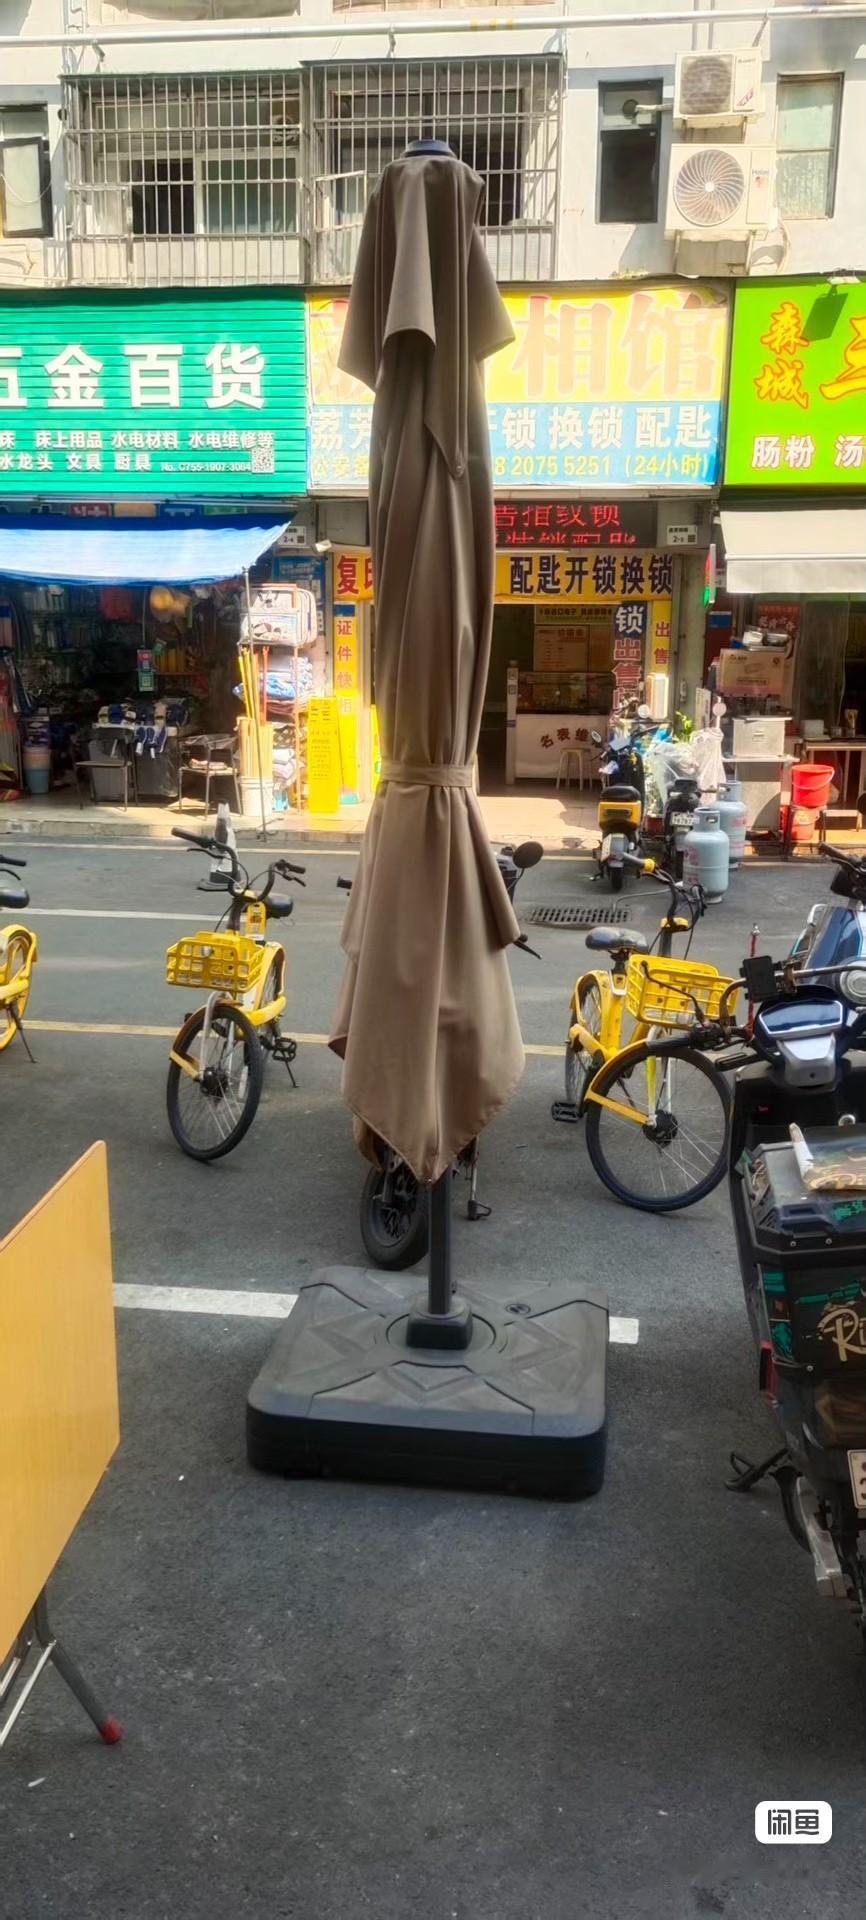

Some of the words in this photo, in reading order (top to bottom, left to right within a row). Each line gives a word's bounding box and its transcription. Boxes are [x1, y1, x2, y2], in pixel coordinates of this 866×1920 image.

[754, 301, 810, 409] 森城
[36, 431, 103, 449] 床上用品
[111, 431, 178, 449] 水电材料
[488, 407, 537, 450] 锁
[549, 406, 624, 450] 换锁
[635, 405, 717, 449] 配匙
[66, 453, 103, 471] 文具
[115, 453, 151, 471] 厨具
[511, 455, 558, 475] 2075
[563, 455, 611, 475] 5251
[752, 435, 815, 469] 肠粉
[510, 555, 673, 595] 配匙开锁换锁
[654, 621, 671, 664] 出售
